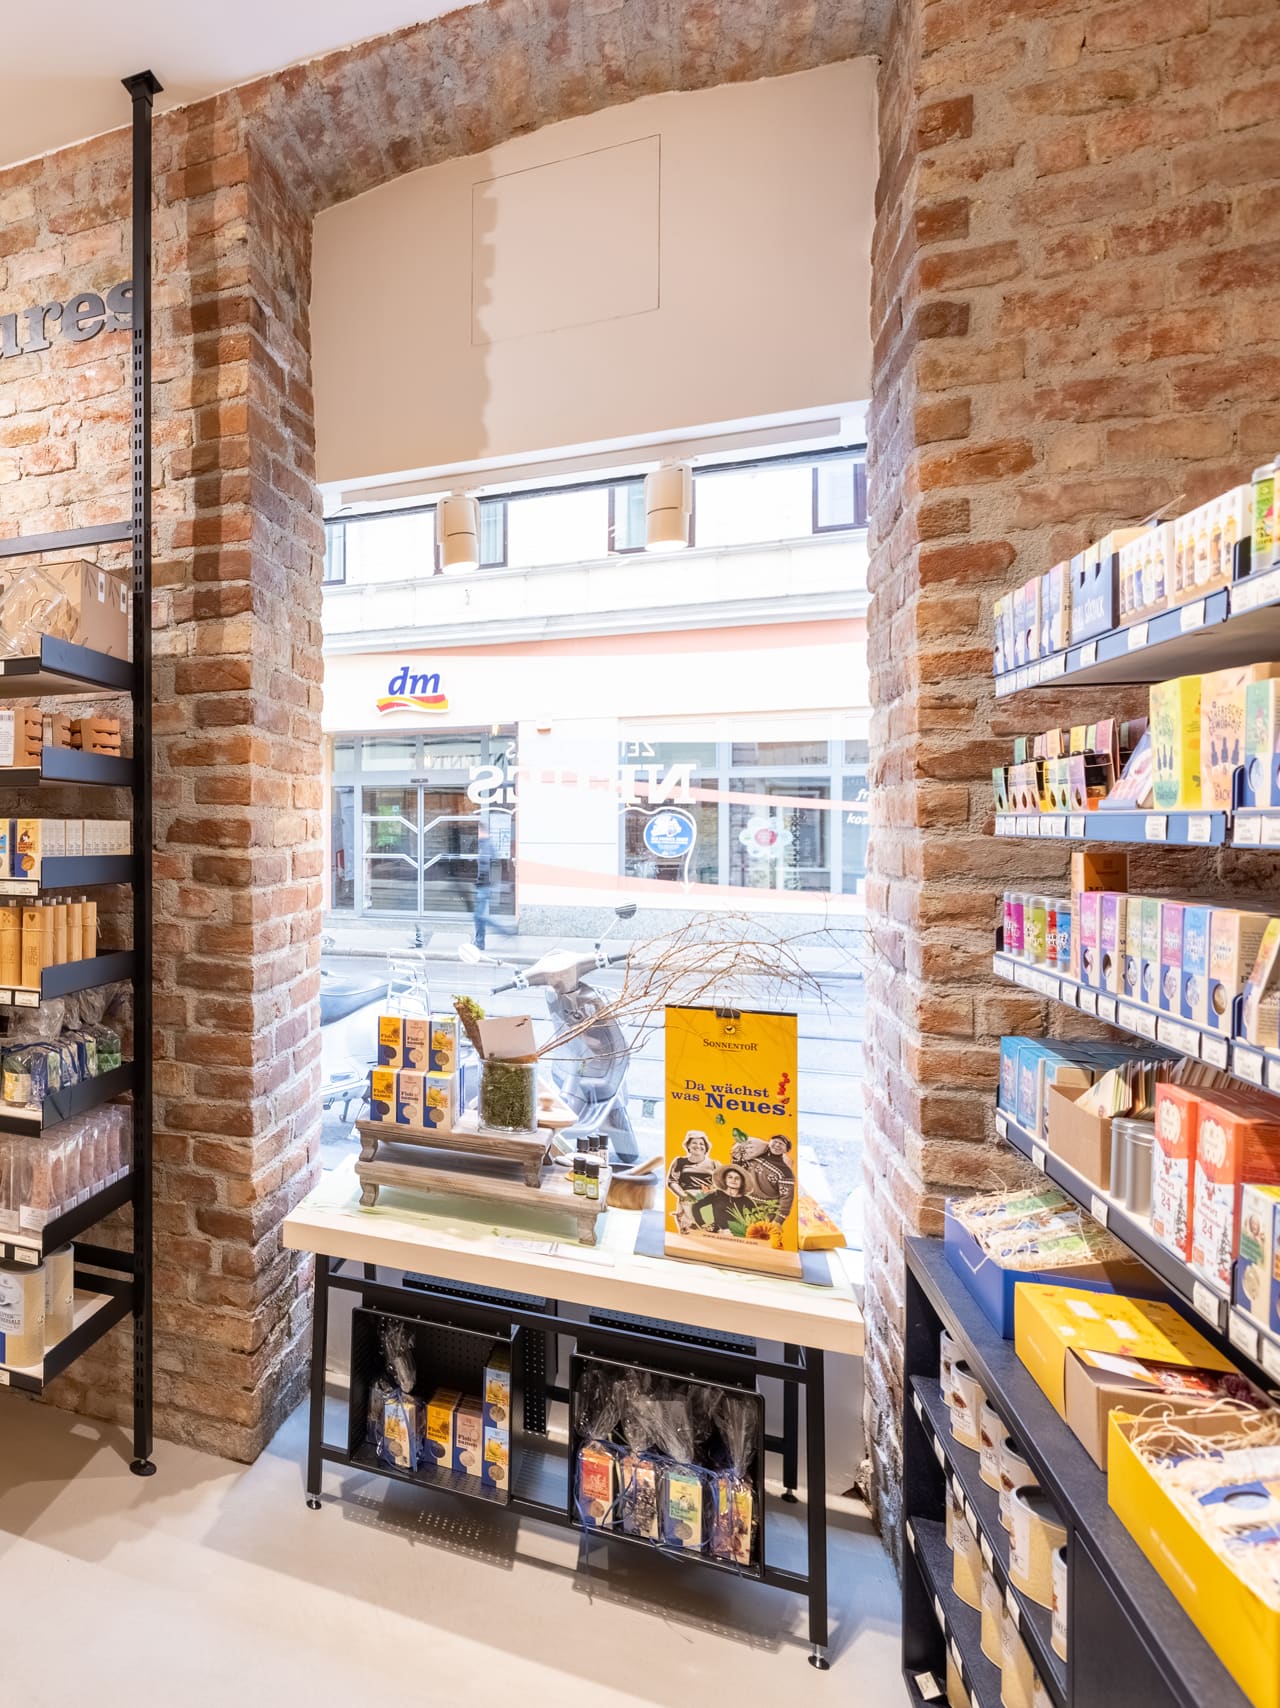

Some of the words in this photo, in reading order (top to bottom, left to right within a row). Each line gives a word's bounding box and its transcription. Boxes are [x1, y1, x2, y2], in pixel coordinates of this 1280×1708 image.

[388, 666, 440, 695] dm
[671, 1091, 700, 1102] was
[684, 1079, 706, 1092] Da
[711, 1082, 770, 1098] wächst
